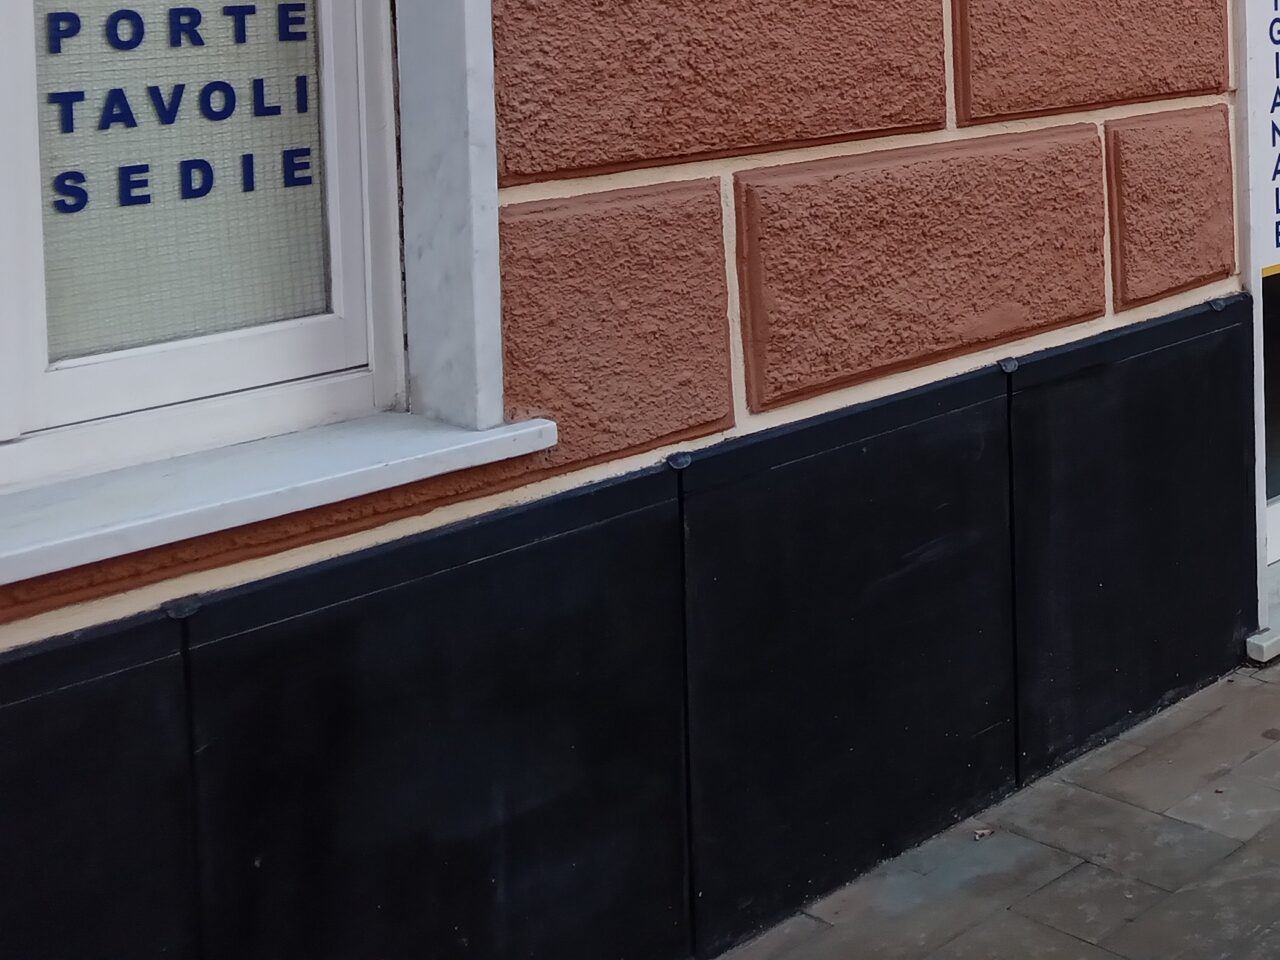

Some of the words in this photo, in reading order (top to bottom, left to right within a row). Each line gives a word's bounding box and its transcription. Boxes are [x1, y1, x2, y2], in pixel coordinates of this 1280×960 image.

[47, 3, 307, 54] PORTE
[48, 75, 309, 134] TAVOLI
[52, 148, 313, 214] SEDIE
